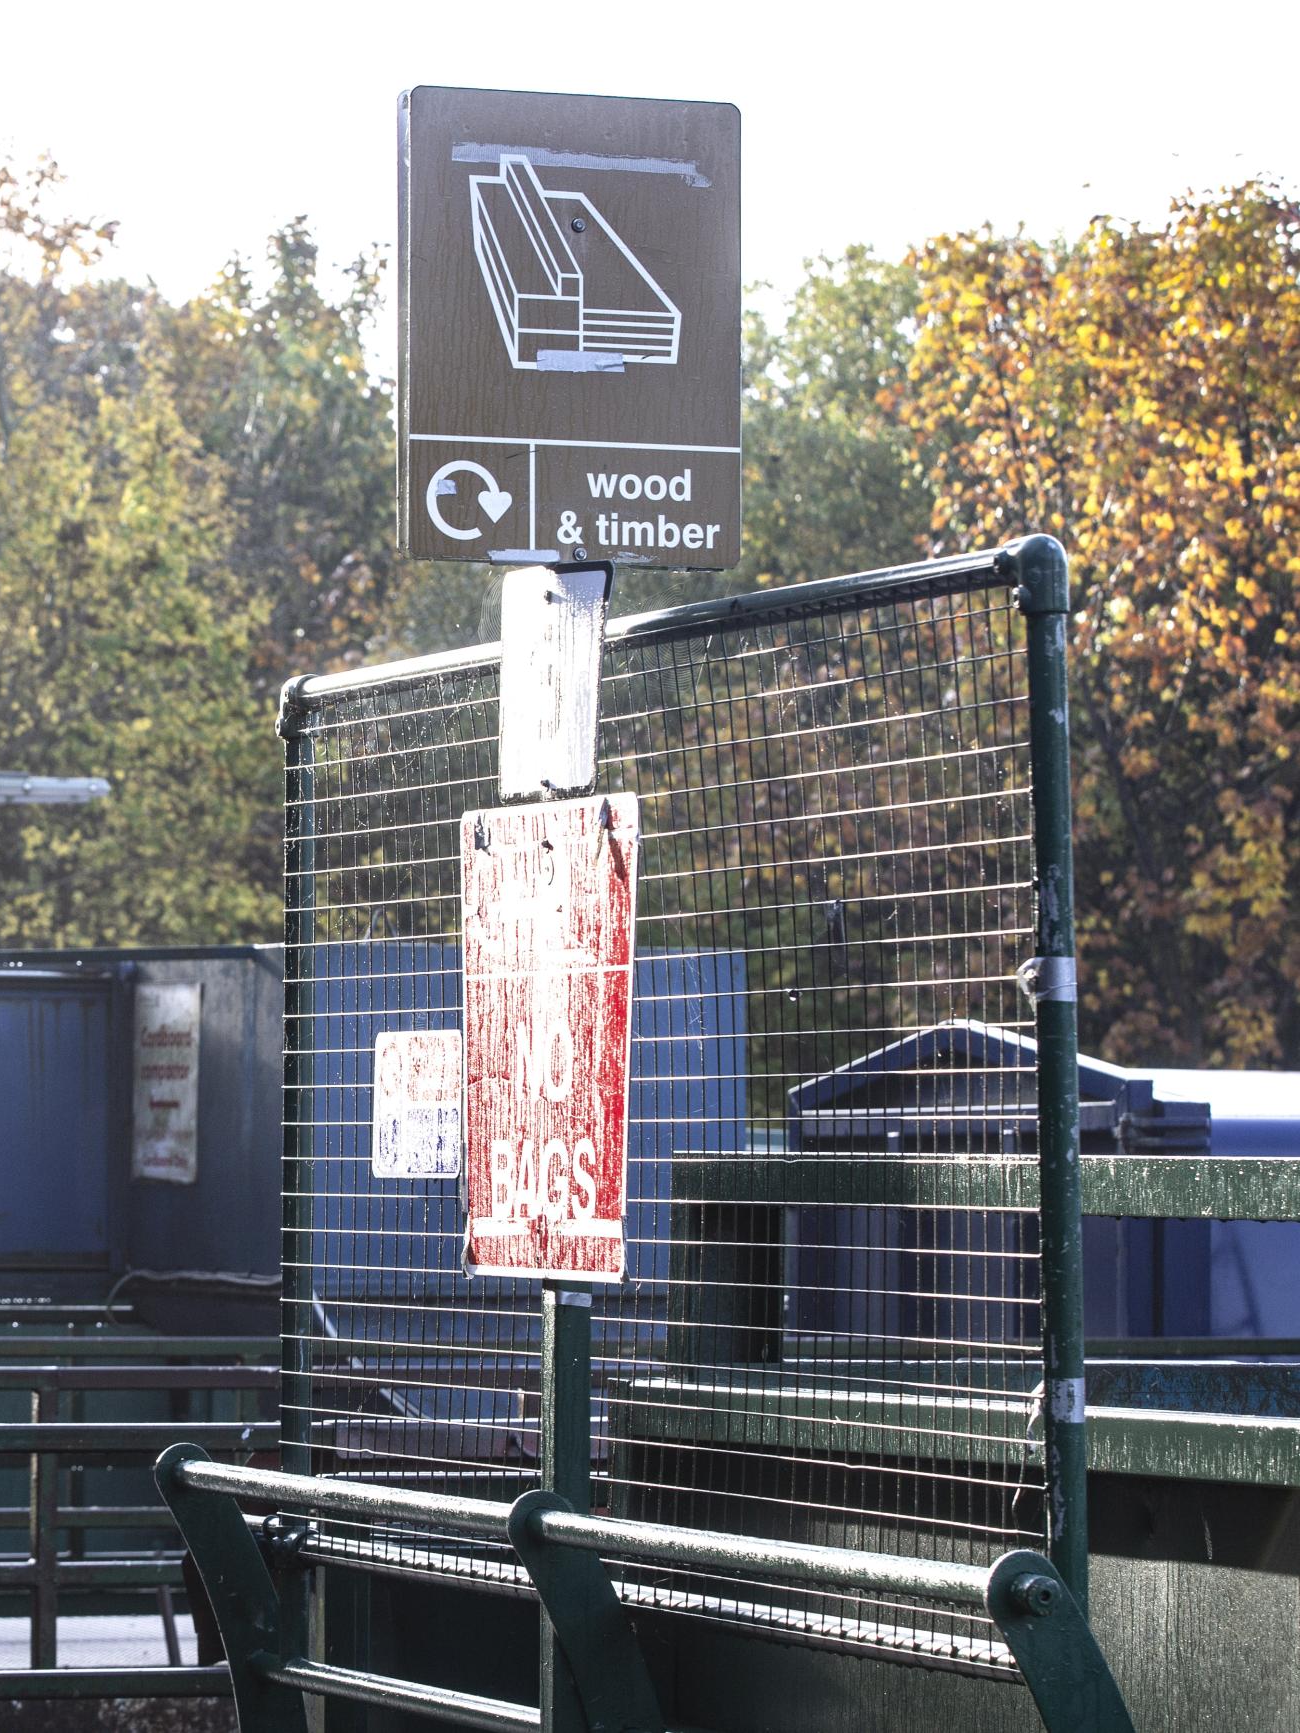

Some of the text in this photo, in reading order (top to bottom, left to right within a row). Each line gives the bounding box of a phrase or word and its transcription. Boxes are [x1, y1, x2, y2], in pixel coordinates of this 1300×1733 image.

[586, 469, 692, 501] wood
[557, 511, 720, 549] & timber
[516, 1019, 573, 1103] NO
[491, 1137, 597, 1219] BAGS
